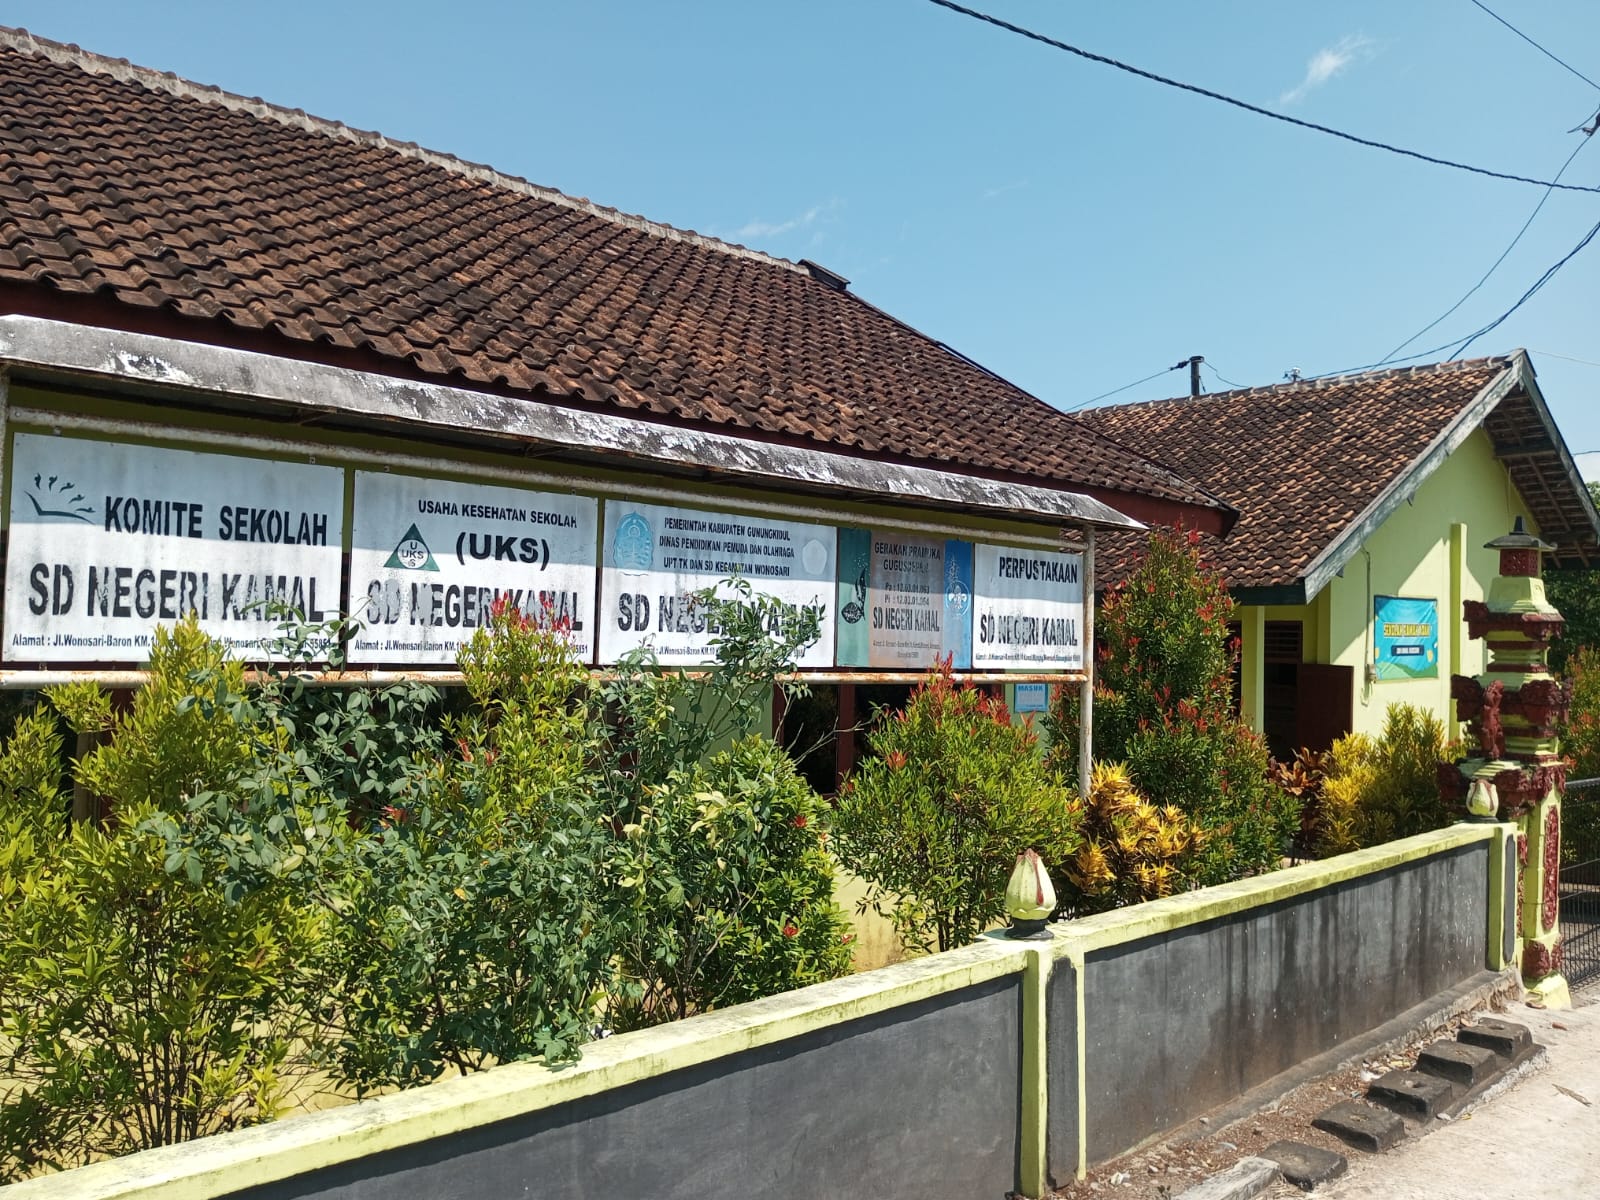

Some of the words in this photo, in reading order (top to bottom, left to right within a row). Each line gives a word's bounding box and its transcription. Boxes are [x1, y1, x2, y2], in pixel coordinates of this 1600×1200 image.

[105, 496, 203, 539] KOMITE
[218, 505, 328, 547] SEKOLAH
[418, 498, 459, 516] USAHA
[461, 503, 526, 522] KESEHATAN
[530, 510, 578, 529] SEKOLAH
[664, 517, 707, 533] PEMERINTAH
[708, 521, 746, 537] KABUPATEN
[747, 526, 791, 542] GUNUNGKIDUL
[455, 531, 550, 571] (UKS)
[659, 535, 680, 548] DINAS
[681, 537, 721, 553] PENDIDIKAN
[723, 541, 748, 555] PEMUDA
[749, 544, 762, 556] DAN
[763, 545, 795, 558] OLAHRAGA
[874, 542, 908, 556] GERAKAN
[663, 556, 678, 569] UPT
[678, 558, 688, 570] TK
[690, 559, 704, 571] DAN
[704, 560, 714, 572] SD
[754, 564, 790, 577] WONOSARI
[999, 556, 1078, 584] PERPUSTAKAAN
[29, 562, 74, 617] SD
[87, 566, 209, 620] NEGERI
[221, 573, 325, 623] KAMAL
[366, 578, 402, 625] SD
[617, 592, 650, 632] SD
[873, 606, 883, 629] SD
[885, 608, 913, 631] NEGERI
[914, 608, 940, 632] KAMAL
[12, 633, 45, 646] Alamat
[980, 614, 995, 645] SD
[1042, 617, 1078, 647] KAMAL
